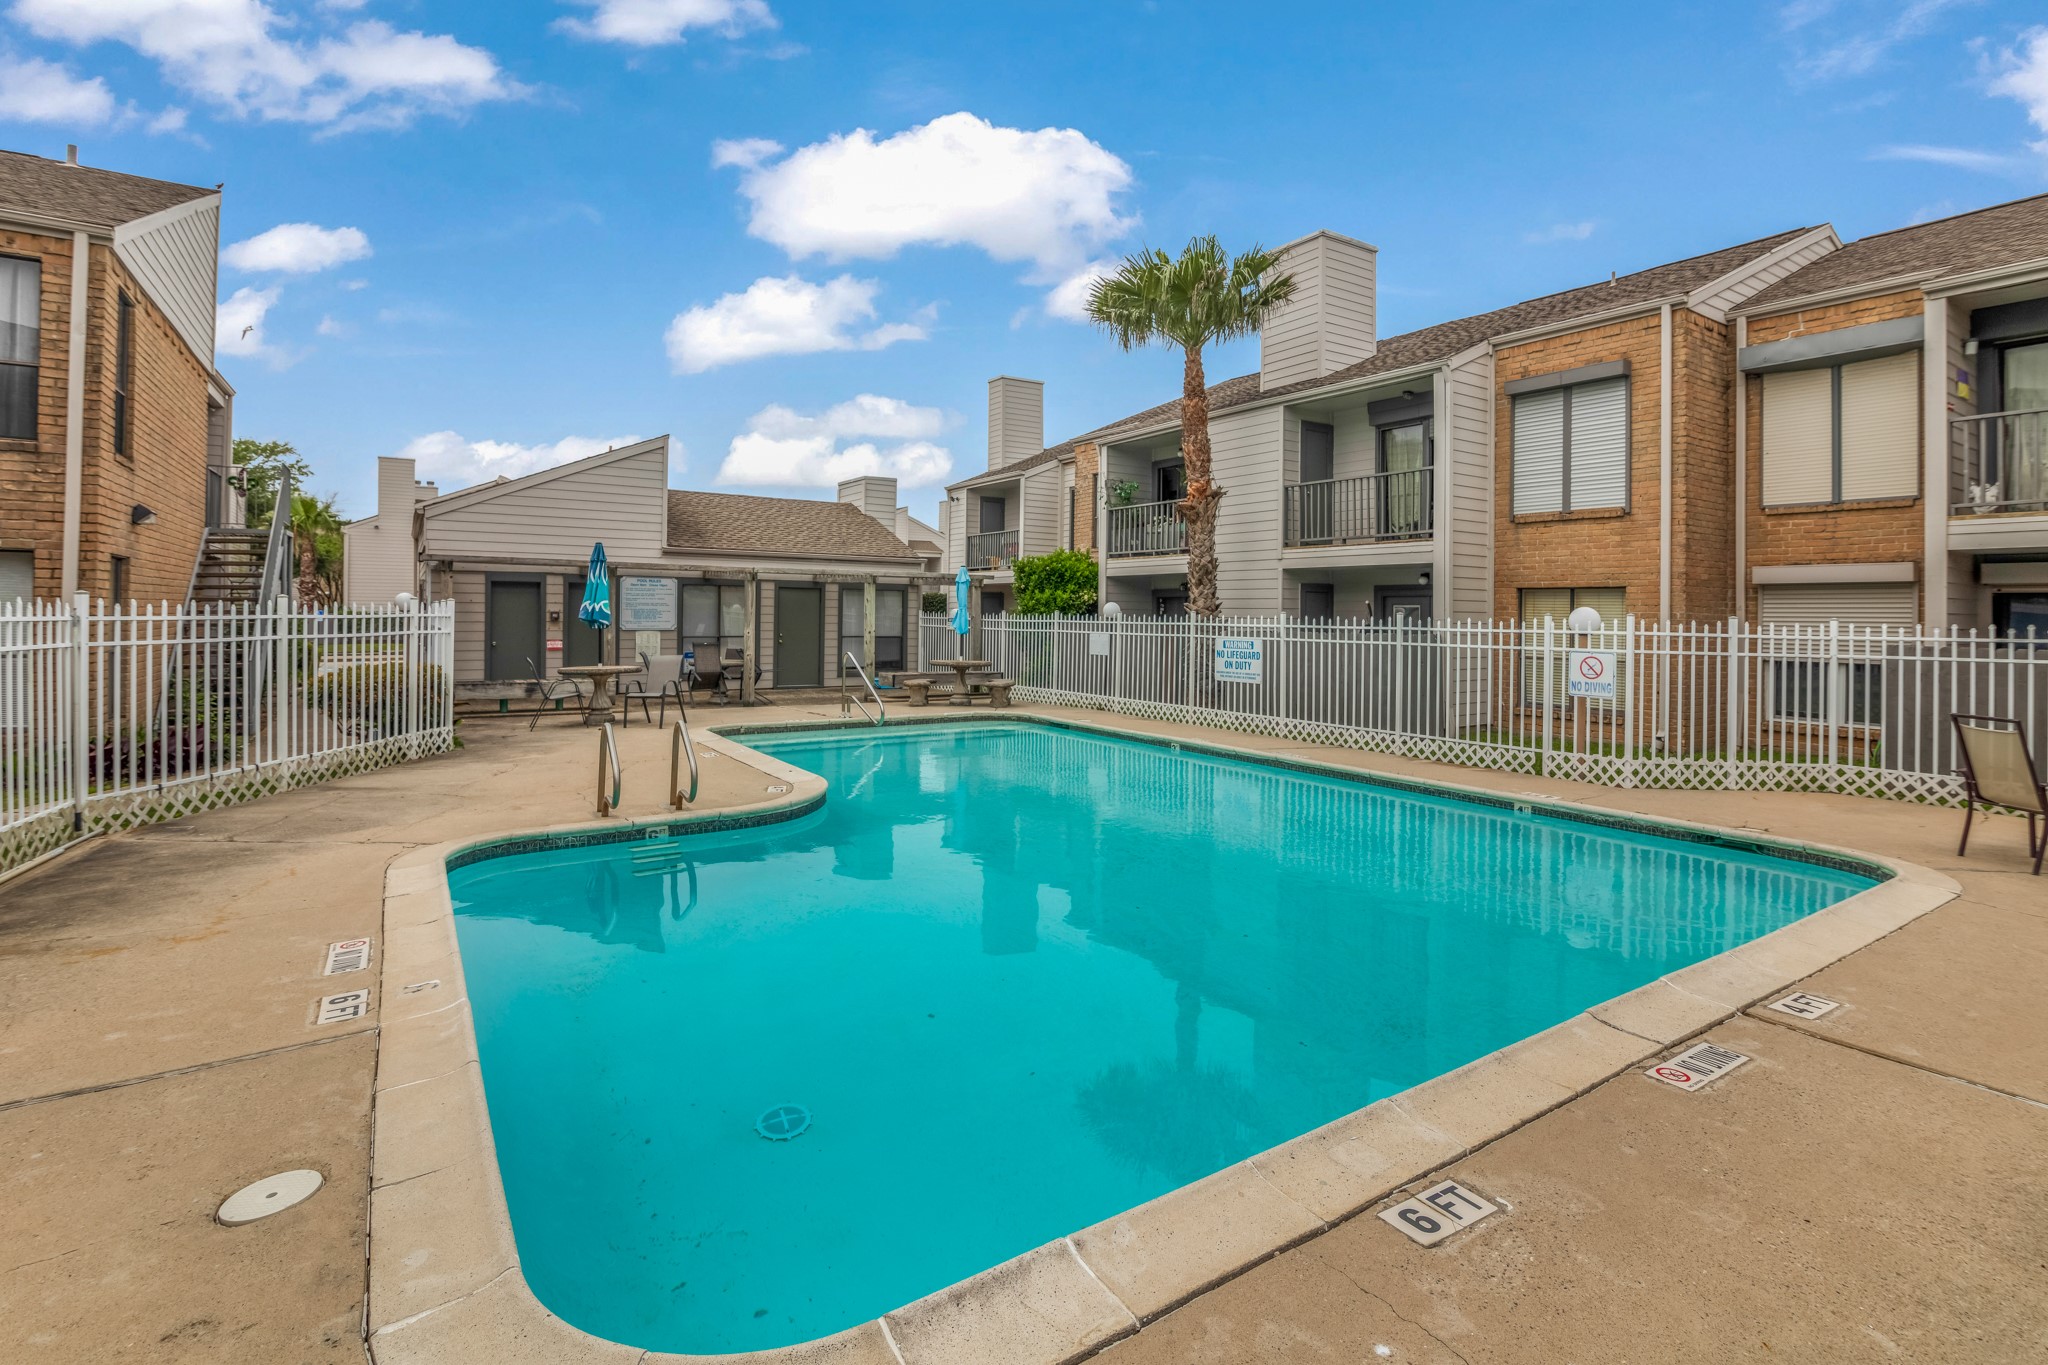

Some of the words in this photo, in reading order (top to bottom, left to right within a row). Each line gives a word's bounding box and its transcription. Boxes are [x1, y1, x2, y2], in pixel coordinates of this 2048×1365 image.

[1225, 640, 1252, 649] WARNING
[1217, 650, 1225, 658] NO
[1227, 650, 1260, 660] LIFEGUARD
[1225, 660, 1233, 669] ON
[1235, 661, 1252, 670] DUTY
[1571, 681, 1582, 691] NO
[1584, 682, 1612, 693] DIVING
[328, 994, 361, 1005] 6
[1791, 994, 1830, 1010] FT
[325, 1004, 360, 1020] FT
[1781, 1003, 1814, 1013] 4
[1688, 1045, 1741, 1070] DIVING
[1674, 1060, 1715, 1077] NO
[1397, 1208, 1441, 1233] 6
[1425, 1185, 1483, 1220] FT
